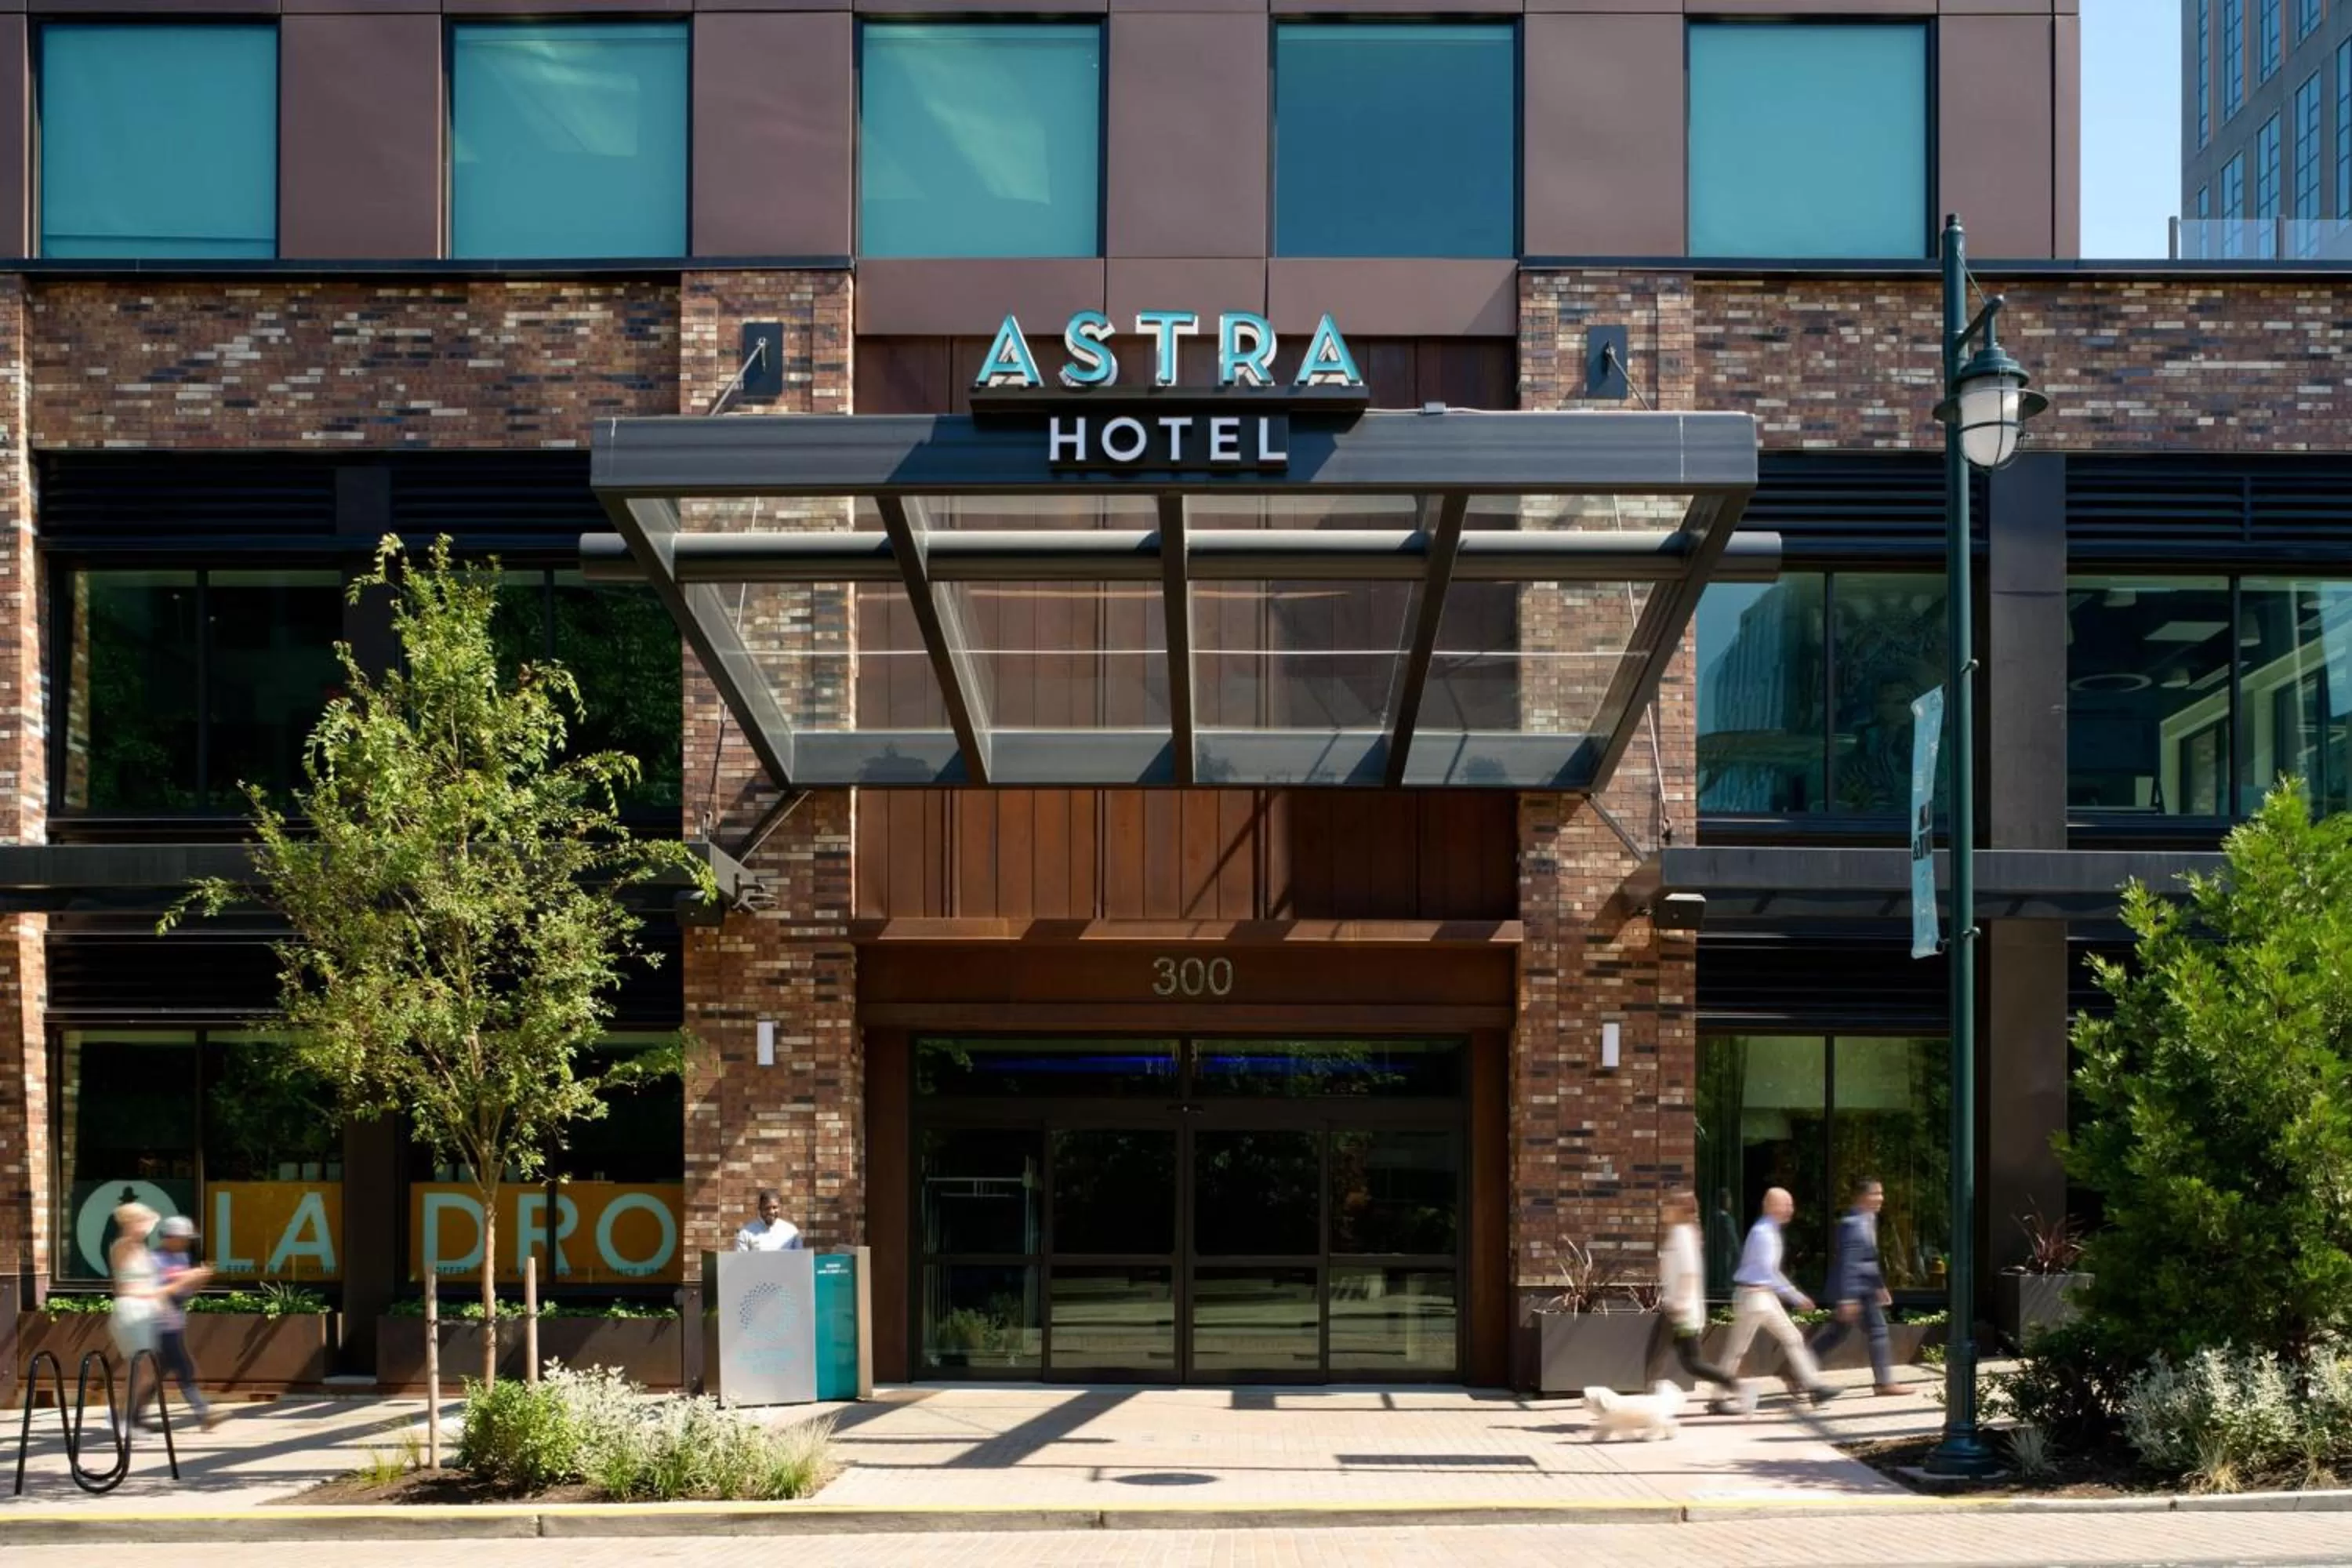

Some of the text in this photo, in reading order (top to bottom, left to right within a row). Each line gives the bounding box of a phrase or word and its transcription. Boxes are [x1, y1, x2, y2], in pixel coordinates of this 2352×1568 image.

[975, 309, 1363, 387] ASTRA
[1049, 416, 1288, 463] HOTEL
[1152, 956, 1234, 996] 300
